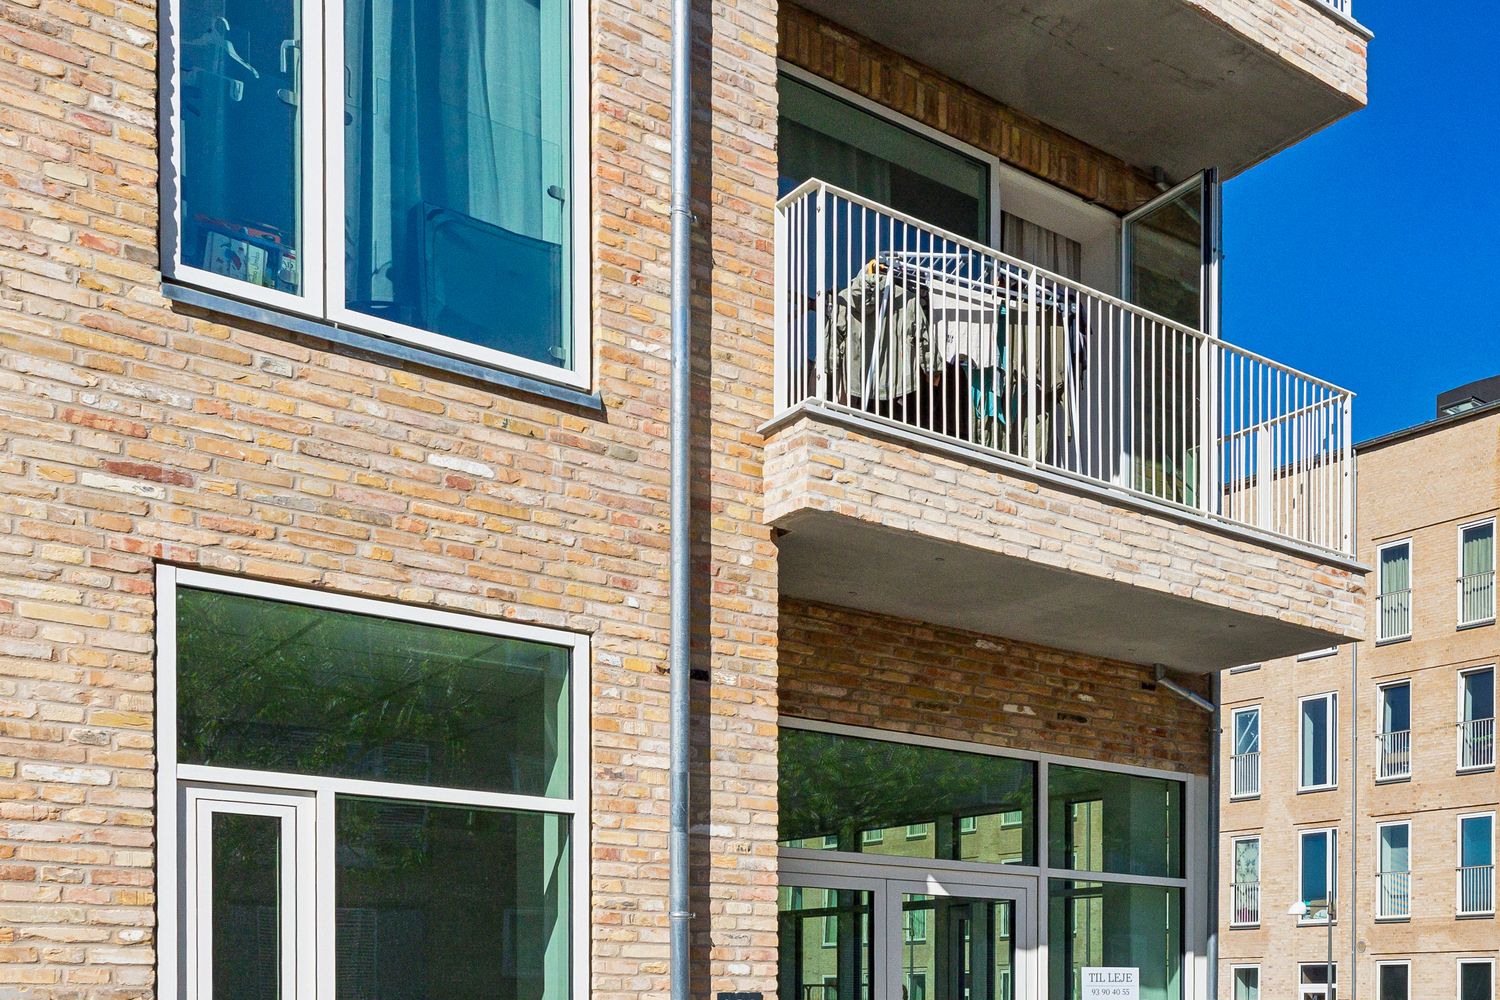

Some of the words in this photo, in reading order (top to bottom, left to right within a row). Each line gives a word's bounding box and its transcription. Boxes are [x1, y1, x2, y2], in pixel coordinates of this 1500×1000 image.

[1088, 972, 1105, 983] TIL
[1108, 972, 1133, 983] LEJE
[1091, 988, 1100, 996] 93
[1102, 988, 1110, 996] 90
